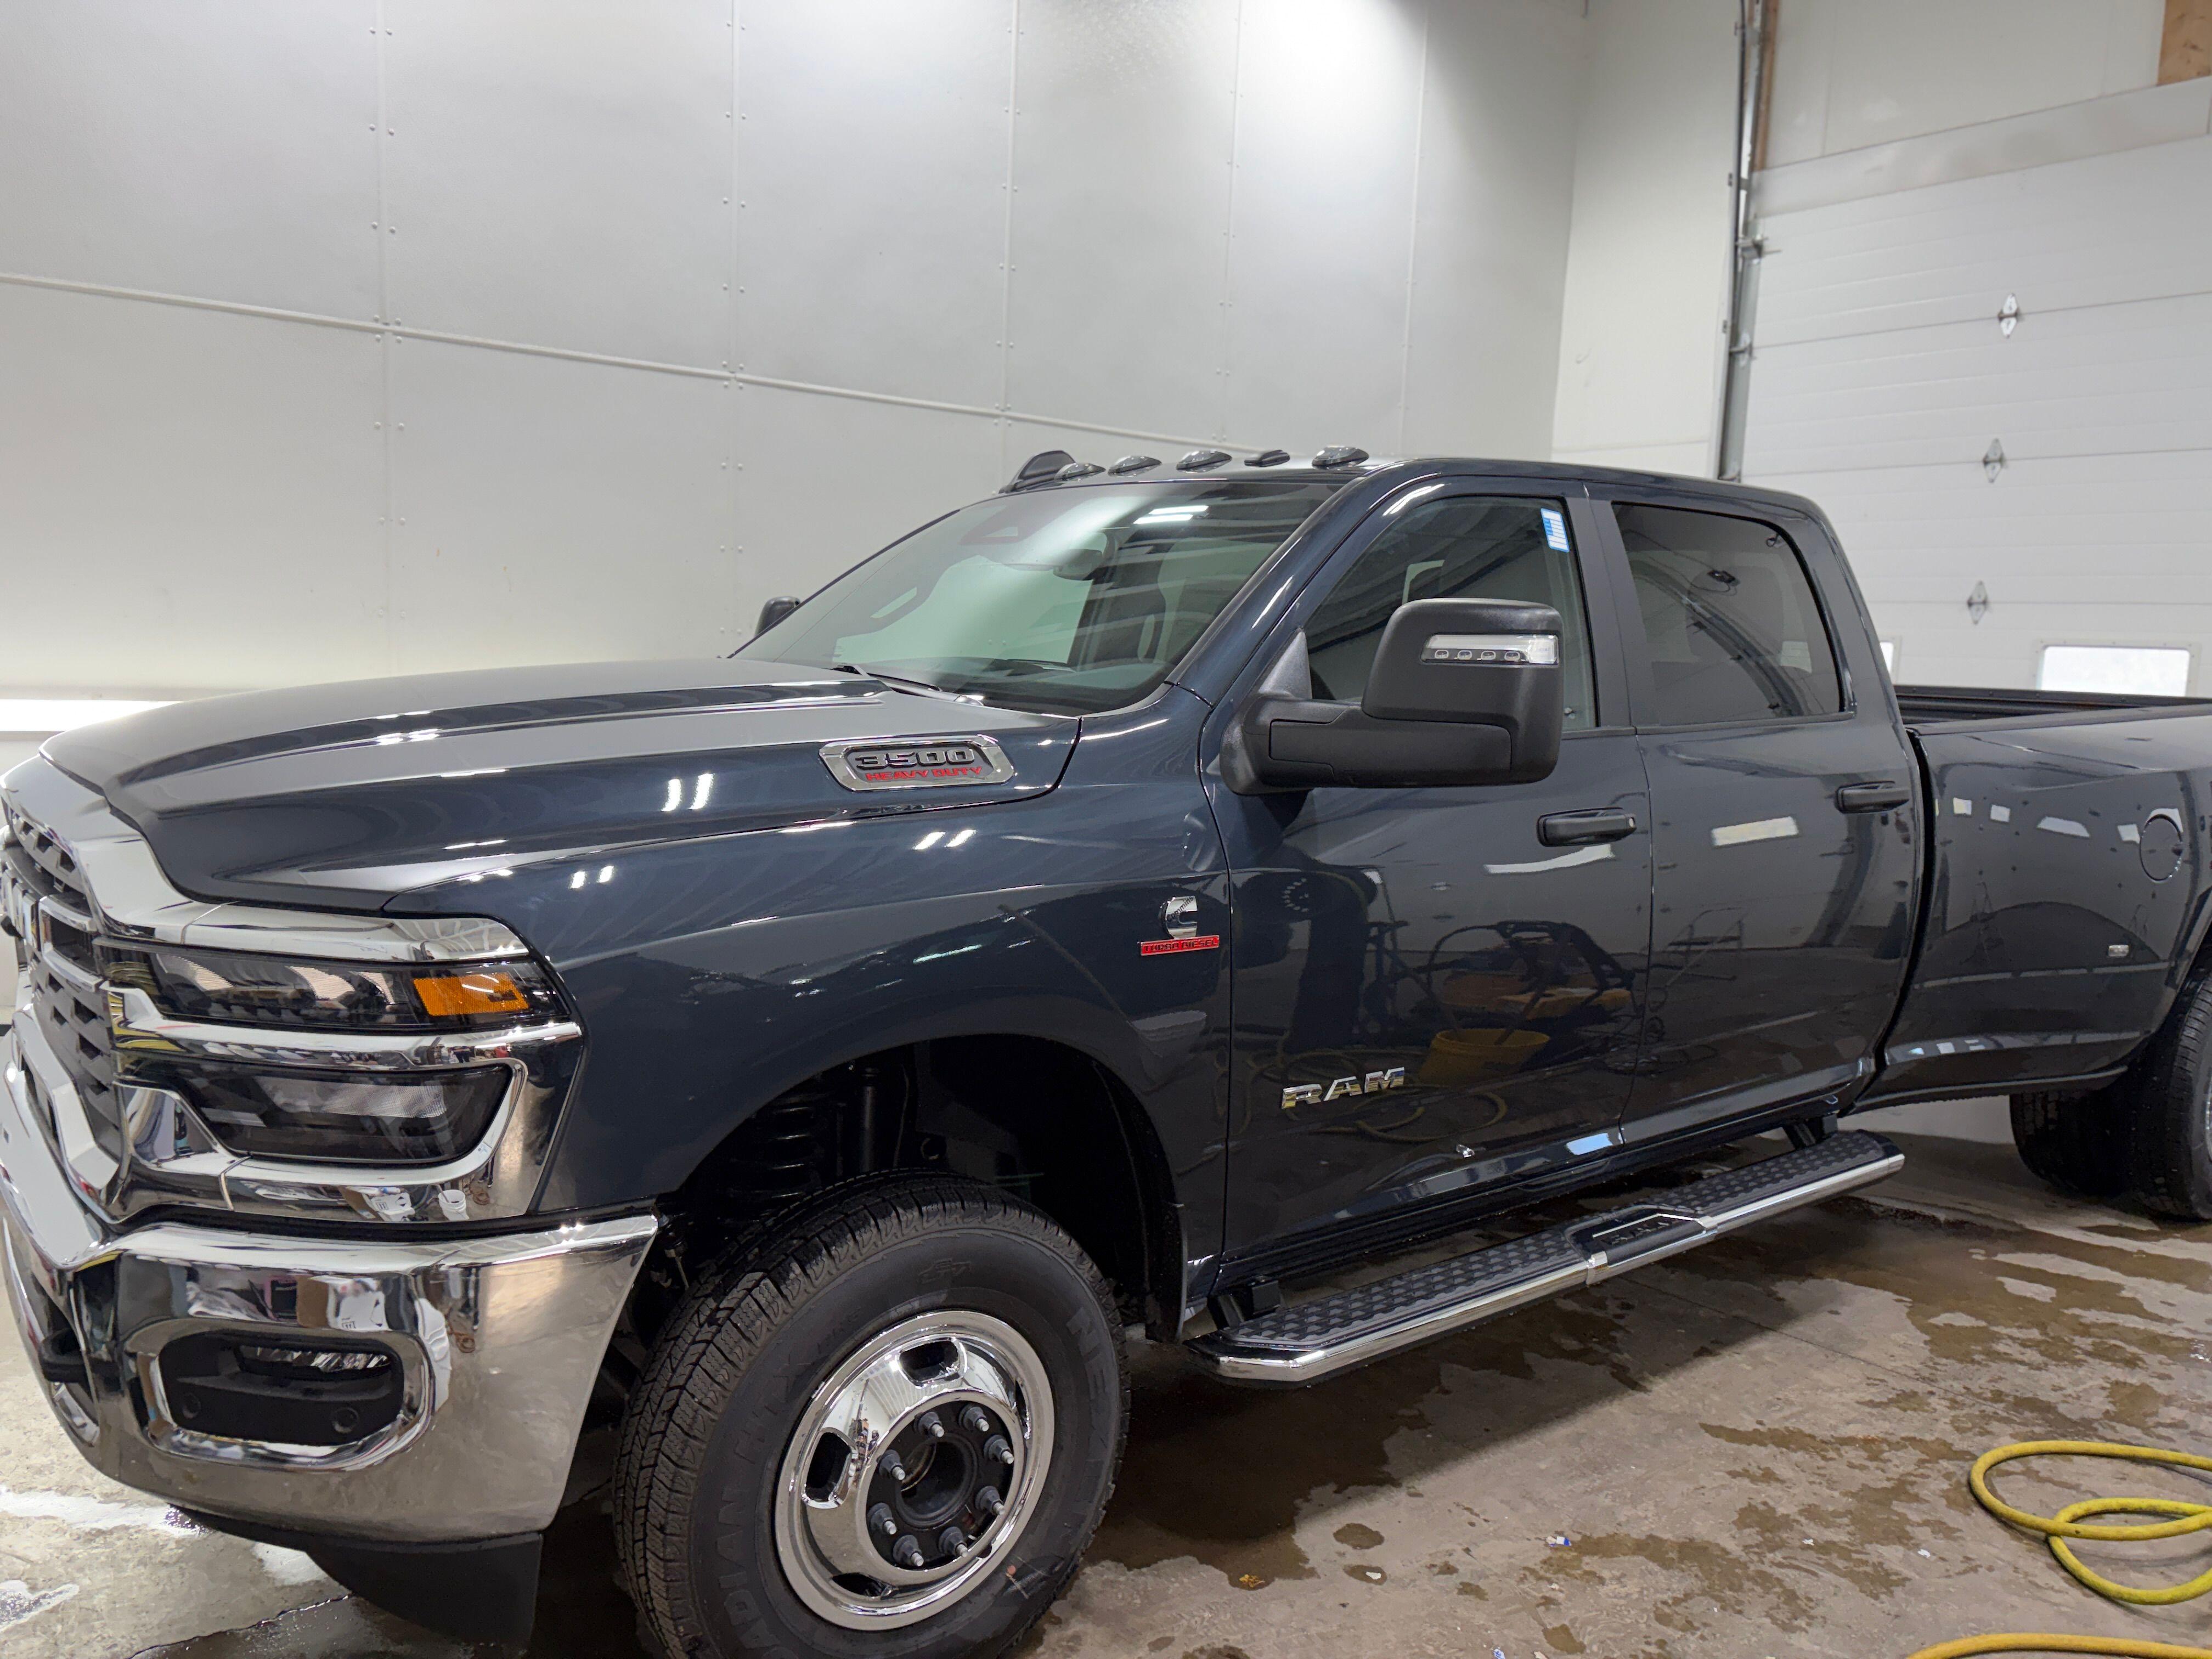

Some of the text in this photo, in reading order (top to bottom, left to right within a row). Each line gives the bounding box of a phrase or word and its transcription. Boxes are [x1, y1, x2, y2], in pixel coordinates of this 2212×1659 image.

[855, 749, 975, 770] 3500
[865, 766, 983, 781] HEAVY DUTY
[1181, 937, 1218, 949] DIESEL
[1281, 1066, 1405, 1110] RAM
